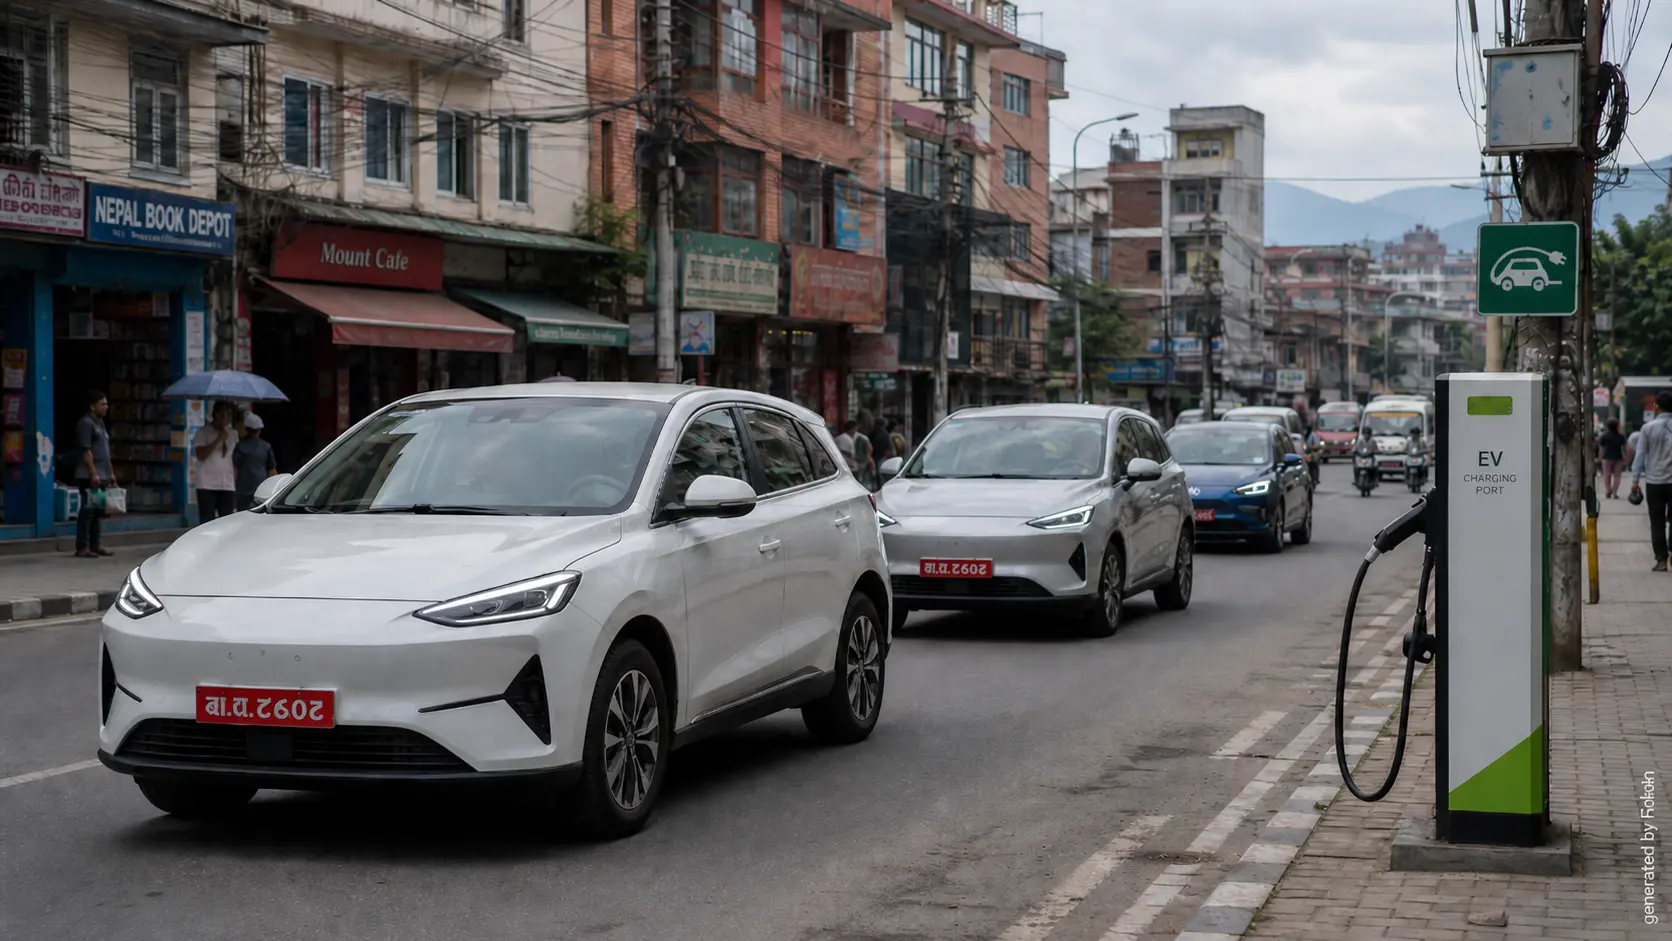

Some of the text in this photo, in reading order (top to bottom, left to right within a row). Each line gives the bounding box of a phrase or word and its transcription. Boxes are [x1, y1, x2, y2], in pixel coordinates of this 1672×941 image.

[95, 195, 142, 227] NEPAL
[145, 202, 185, 233] BOOK
[188, 208, 232, 238] DEPOT
[320, 241, 409, 271] Mount Cafe
[1478, 450, 1504, 467] EV
[1463, 473, 1517, 483] CHARGING
[1475, 486, 1505, 495] PORT
